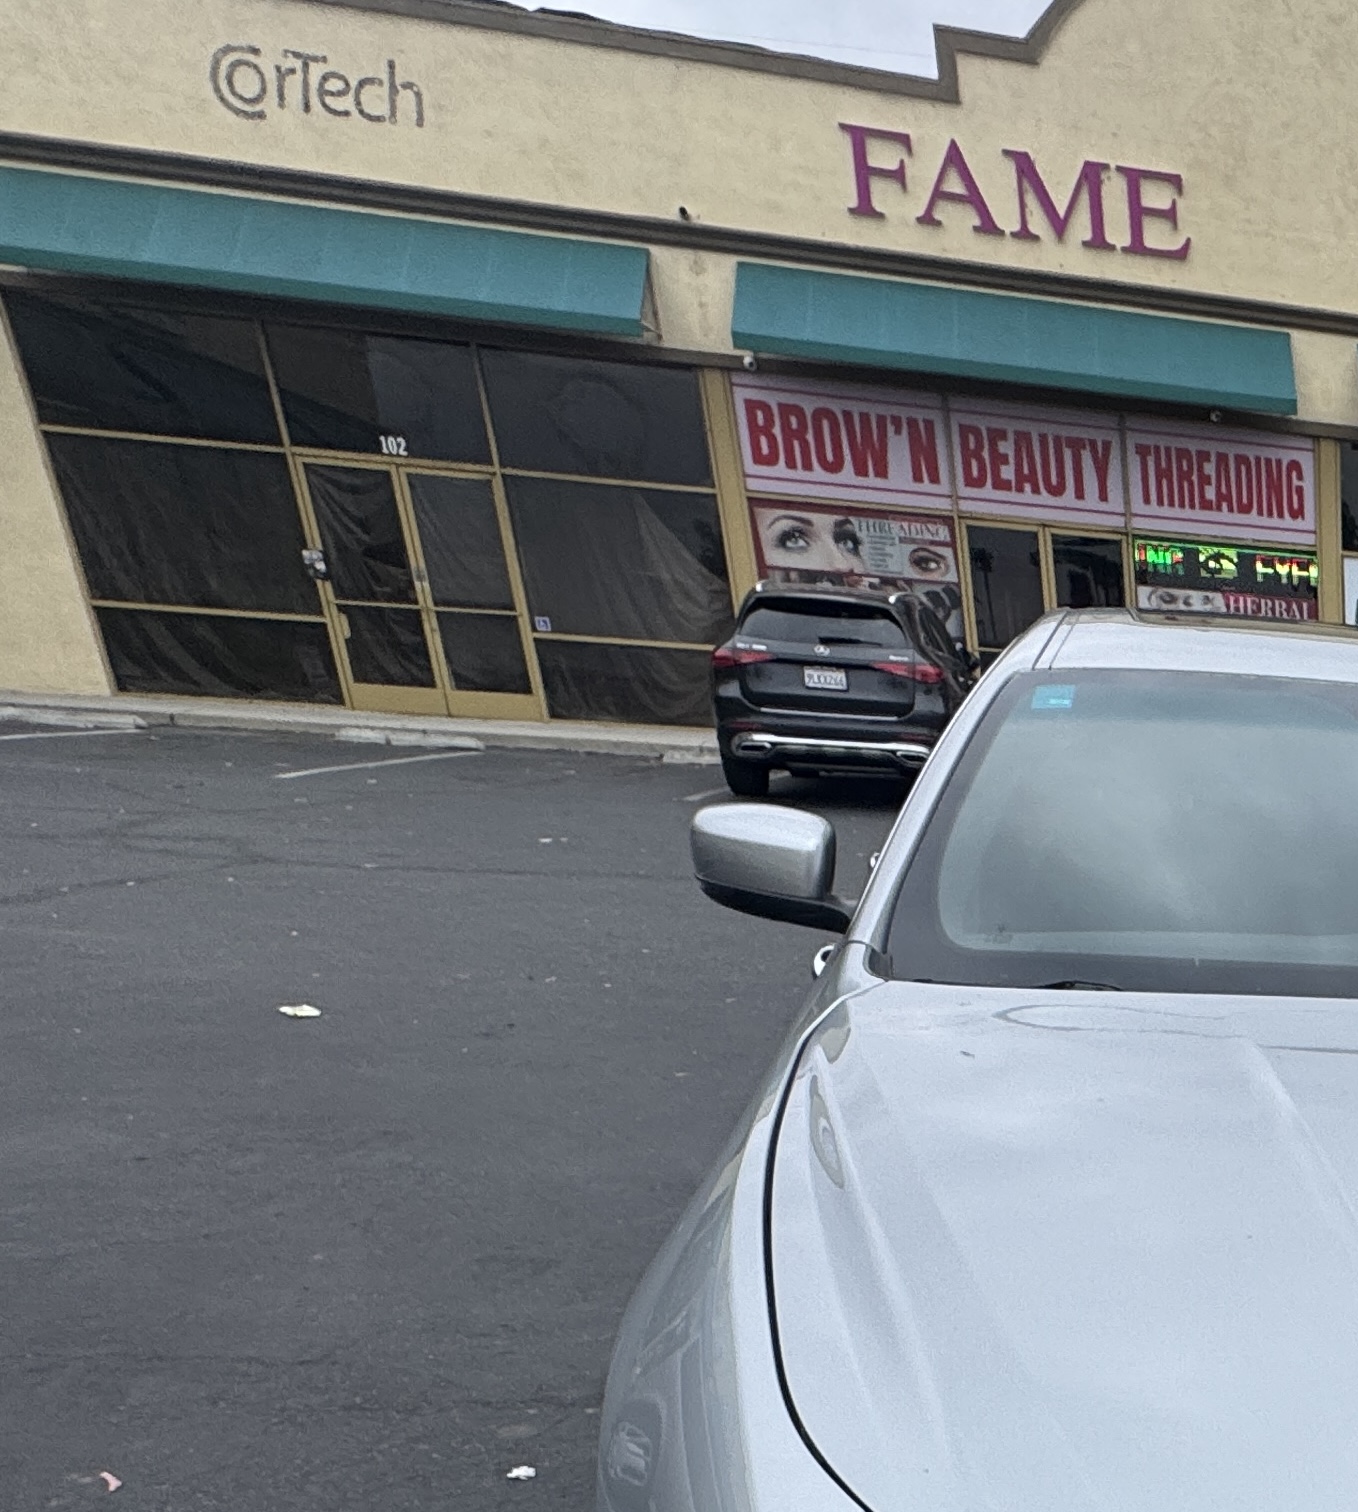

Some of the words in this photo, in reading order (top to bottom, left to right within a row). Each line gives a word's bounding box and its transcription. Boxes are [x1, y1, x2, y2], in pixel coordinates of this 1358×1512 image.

[838, 122, 1192, 261] FAME
[379, 435, 408, 456] 102
[743, 398, 941, 485] BROW'N
[957, 422, 1112, 502] BEAUTY
[1134, 442, 1306, 522] THREADING
